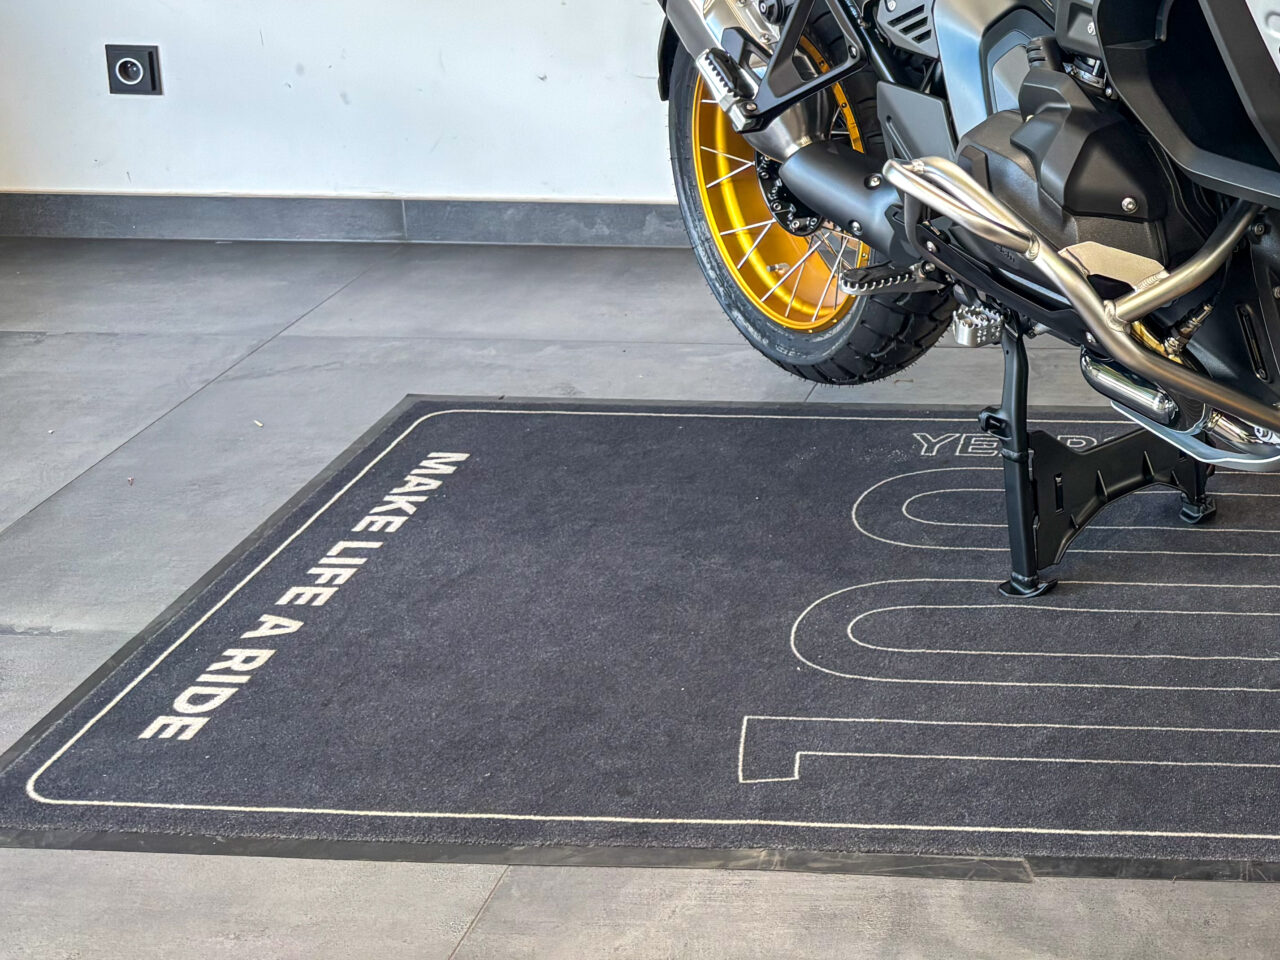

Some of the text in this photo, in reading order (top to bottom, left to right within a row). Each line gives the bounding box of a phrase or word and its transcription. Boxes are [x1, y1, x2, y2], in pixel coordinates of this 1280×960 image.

[137, 451, 471, 741] MAKE LIFE A RIDE
